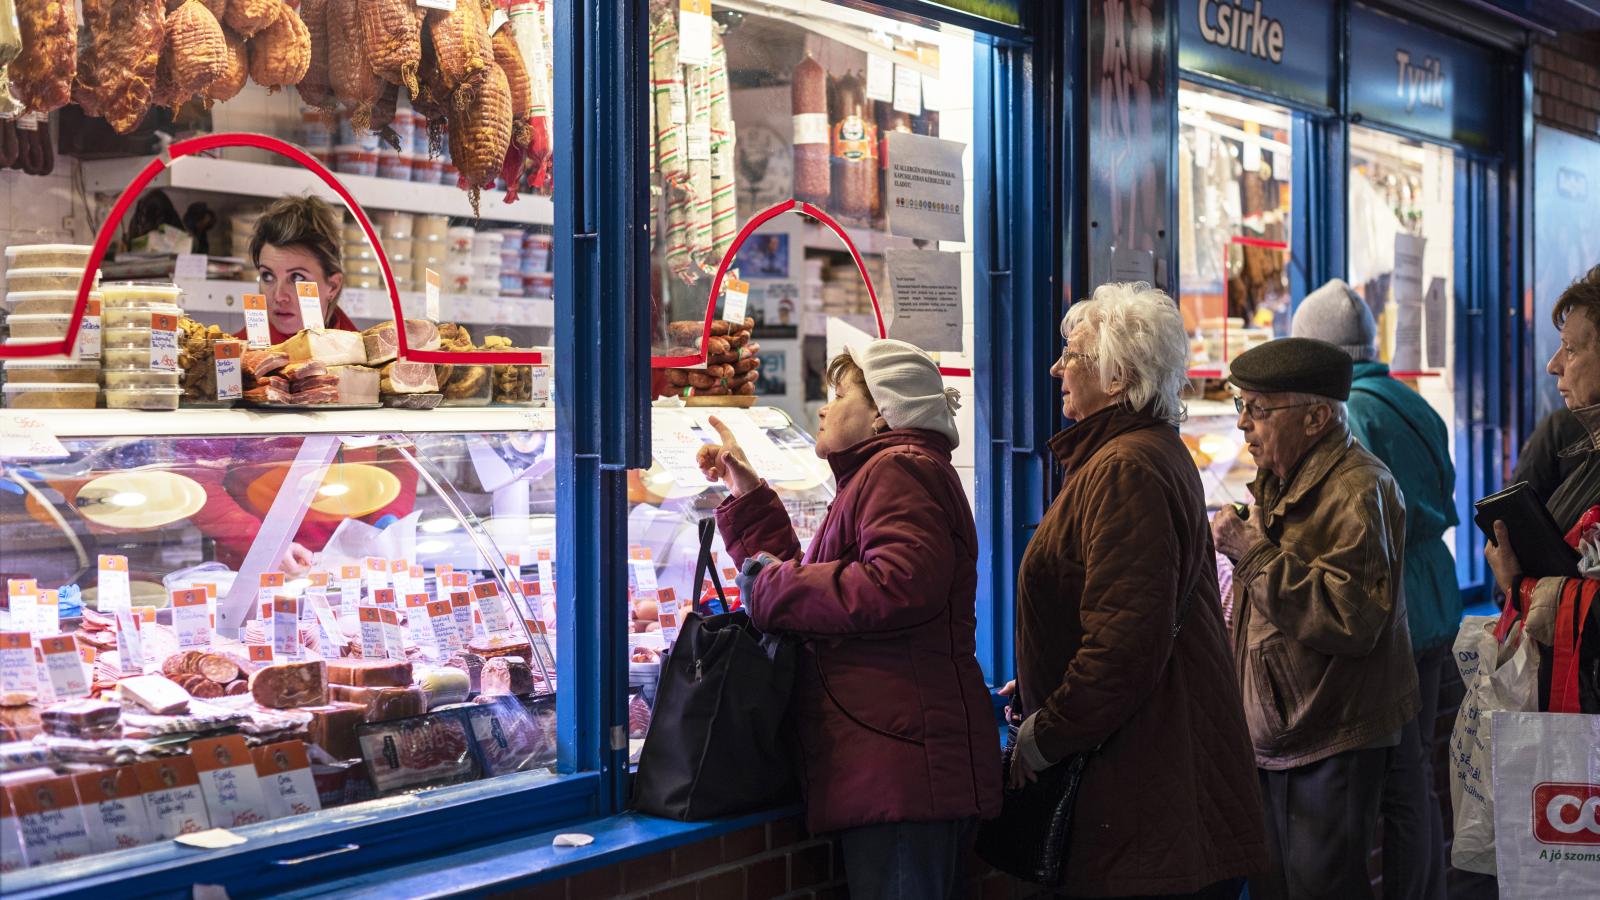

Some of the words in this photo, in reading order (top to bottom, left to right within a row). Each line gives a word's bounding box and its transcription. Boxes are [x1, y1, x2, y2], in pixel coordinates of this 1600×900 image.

[1197, 0, 1285, 63] Csirke
[1396, 50, 1445, 113] Tyúk
[1538, 848, 1548, 860] A
[1548, 848, 1562, 863] jó
